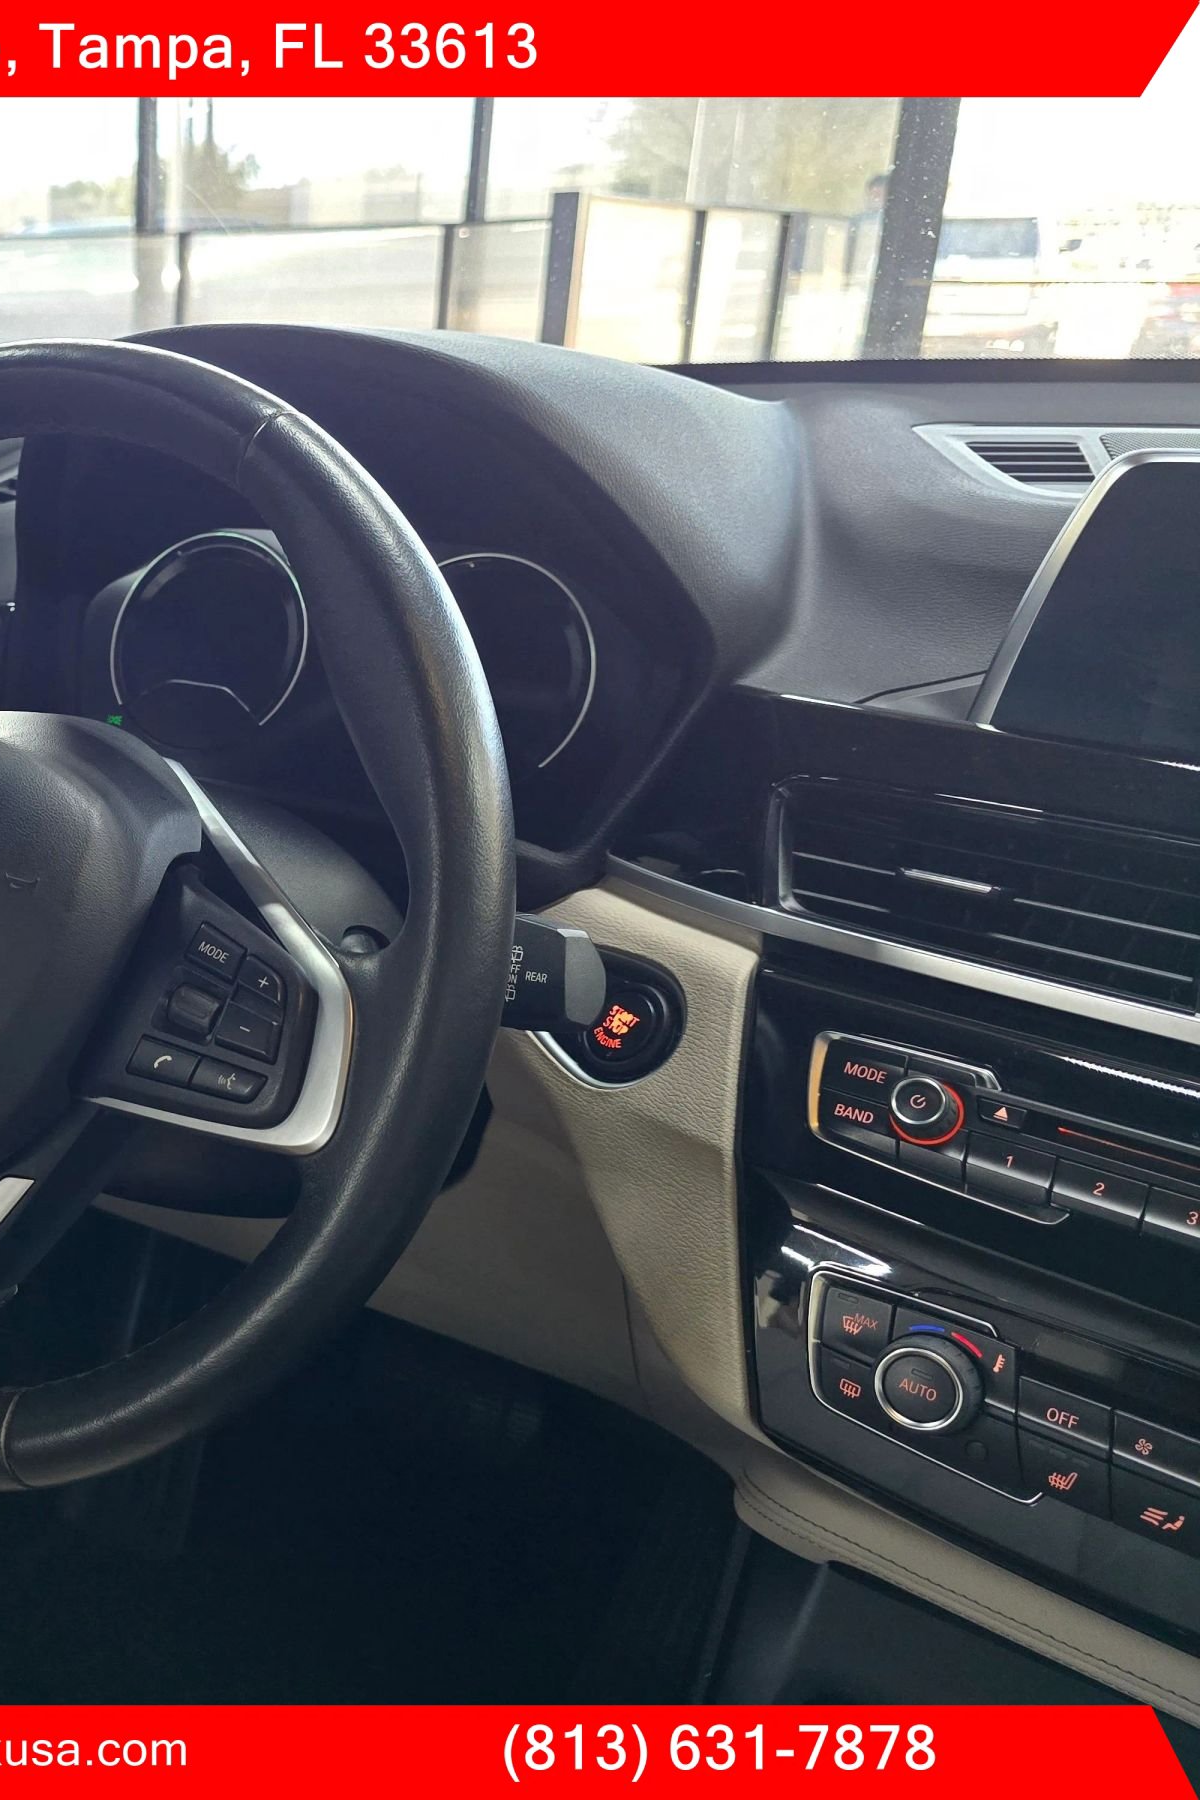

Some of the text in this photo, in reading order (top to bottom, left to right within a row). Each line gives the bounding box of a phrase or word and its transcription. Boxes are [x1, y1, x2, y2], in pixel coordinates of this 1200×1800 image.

[198, 941, 230, 964] MODE
[510, 963, 521, 974] FF
[525, 970, 548, 983] REAR
[593, 1026, 622, 1048] ENGINE
[843, 1061, 888, 1084] MODE
[833, 1103, 874, 1124] BAND
[1006, 1155, 1014, 1169] 1
[1092, 1182, 1105, 1197] 2
[1186, 1211, 1199, 1225] 3
[854, 1313, 879, 1331] MAX
[898, 1378, 938, 1401] AUTO
[1046, 1407, 1080, 1429] OFF
